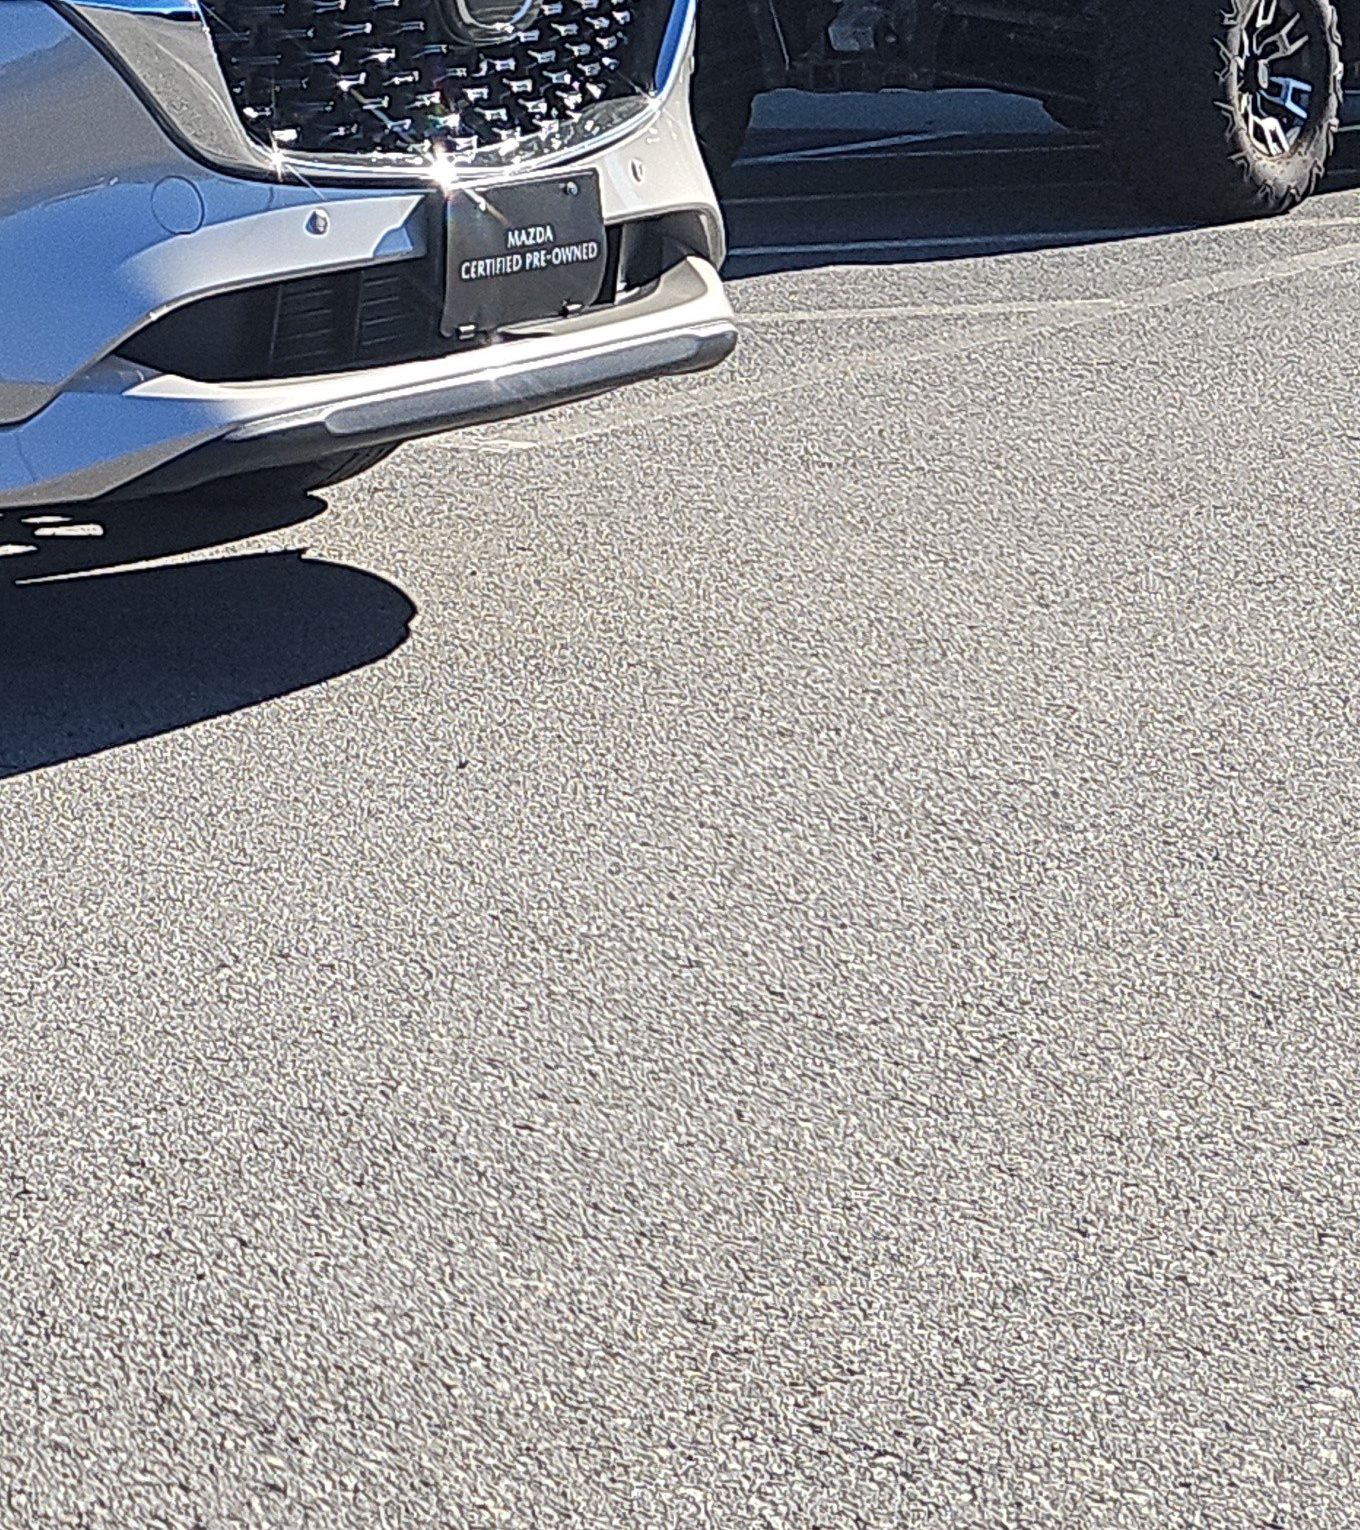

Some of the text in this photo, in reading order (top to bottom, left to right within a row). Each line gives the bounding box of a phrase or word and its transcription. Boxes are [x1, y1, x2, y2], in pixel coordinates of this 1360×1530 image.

[507, 225, 554, 248] MAZDA
[461, 241, 598, 279] CERTIFIED PRE-OWNED
